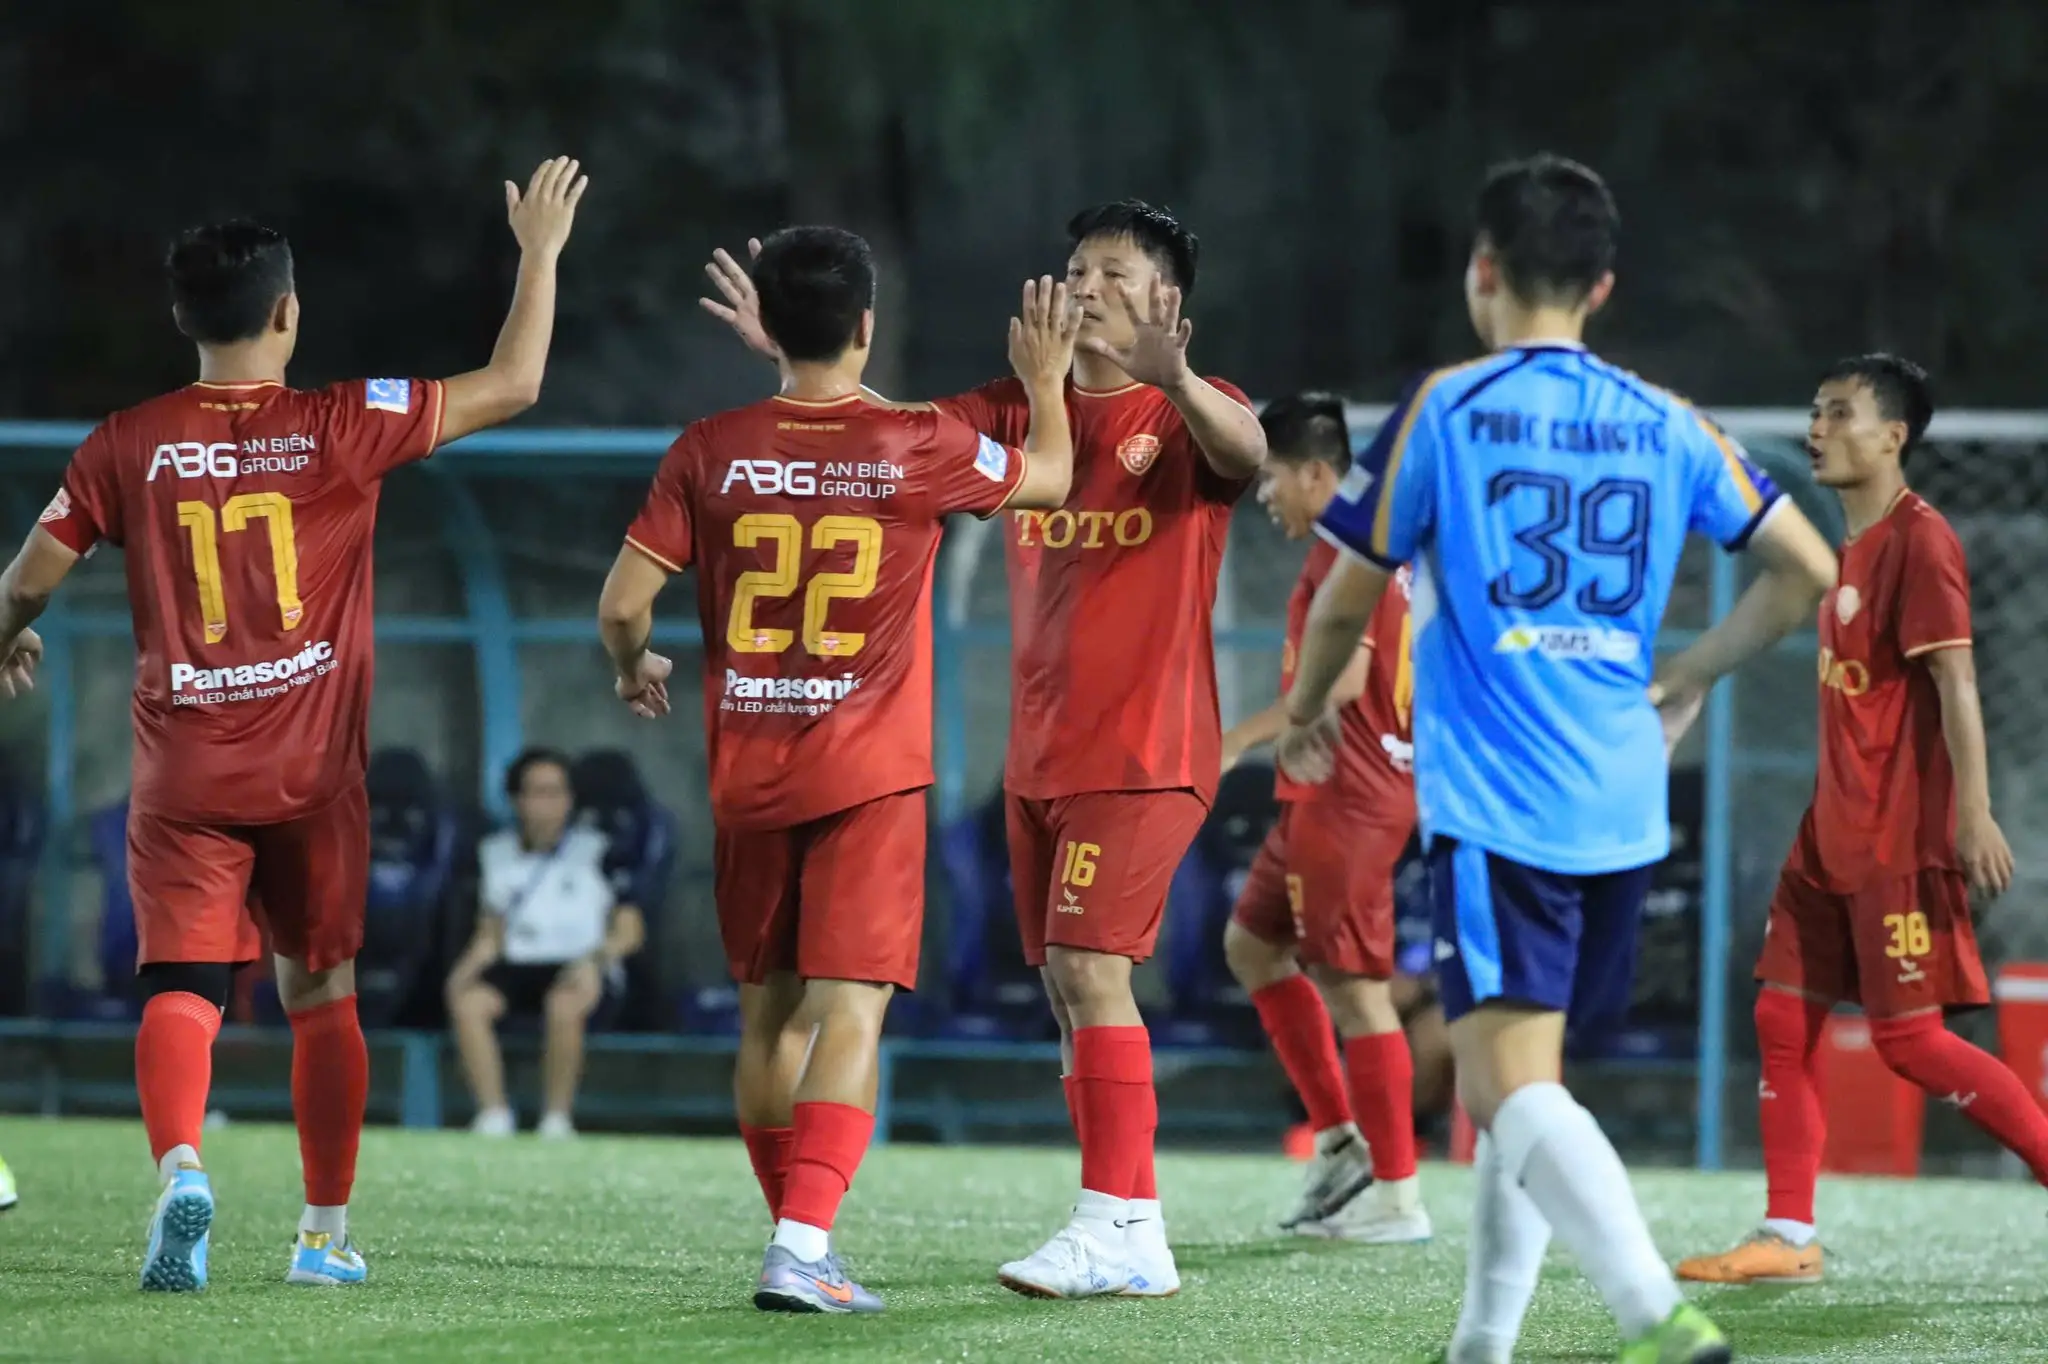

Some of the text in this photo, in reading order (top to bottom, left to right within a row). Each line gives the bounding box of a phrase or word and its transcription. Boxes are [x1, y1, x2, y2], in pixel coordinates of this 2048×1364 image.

[146, 441, 239, 481] ABG
[242, 433, 316, 454] AN BIÊN
[240, 455, 309, 475] GROUP
[720, 460, 817, 496] ABG
[821, 460, 904, 480] AN BIÊN
[821, 481, 896, 499] GROUP
[1014, 506, 1153, 549] TOTO
[1487, 470, 1650, 617] 39
[177, 492, 304, 644] 17
[726, 513, 883, 657] 22
[171, 640, 333, 691] Panasonic
[200, 692, 226, 704] LED
[228, 686, 253, 702] chất
[737, 701, 763, 713] LED
[1061, 841, 1102, 888] 16
[1883, 912, 1931, 957] 38
